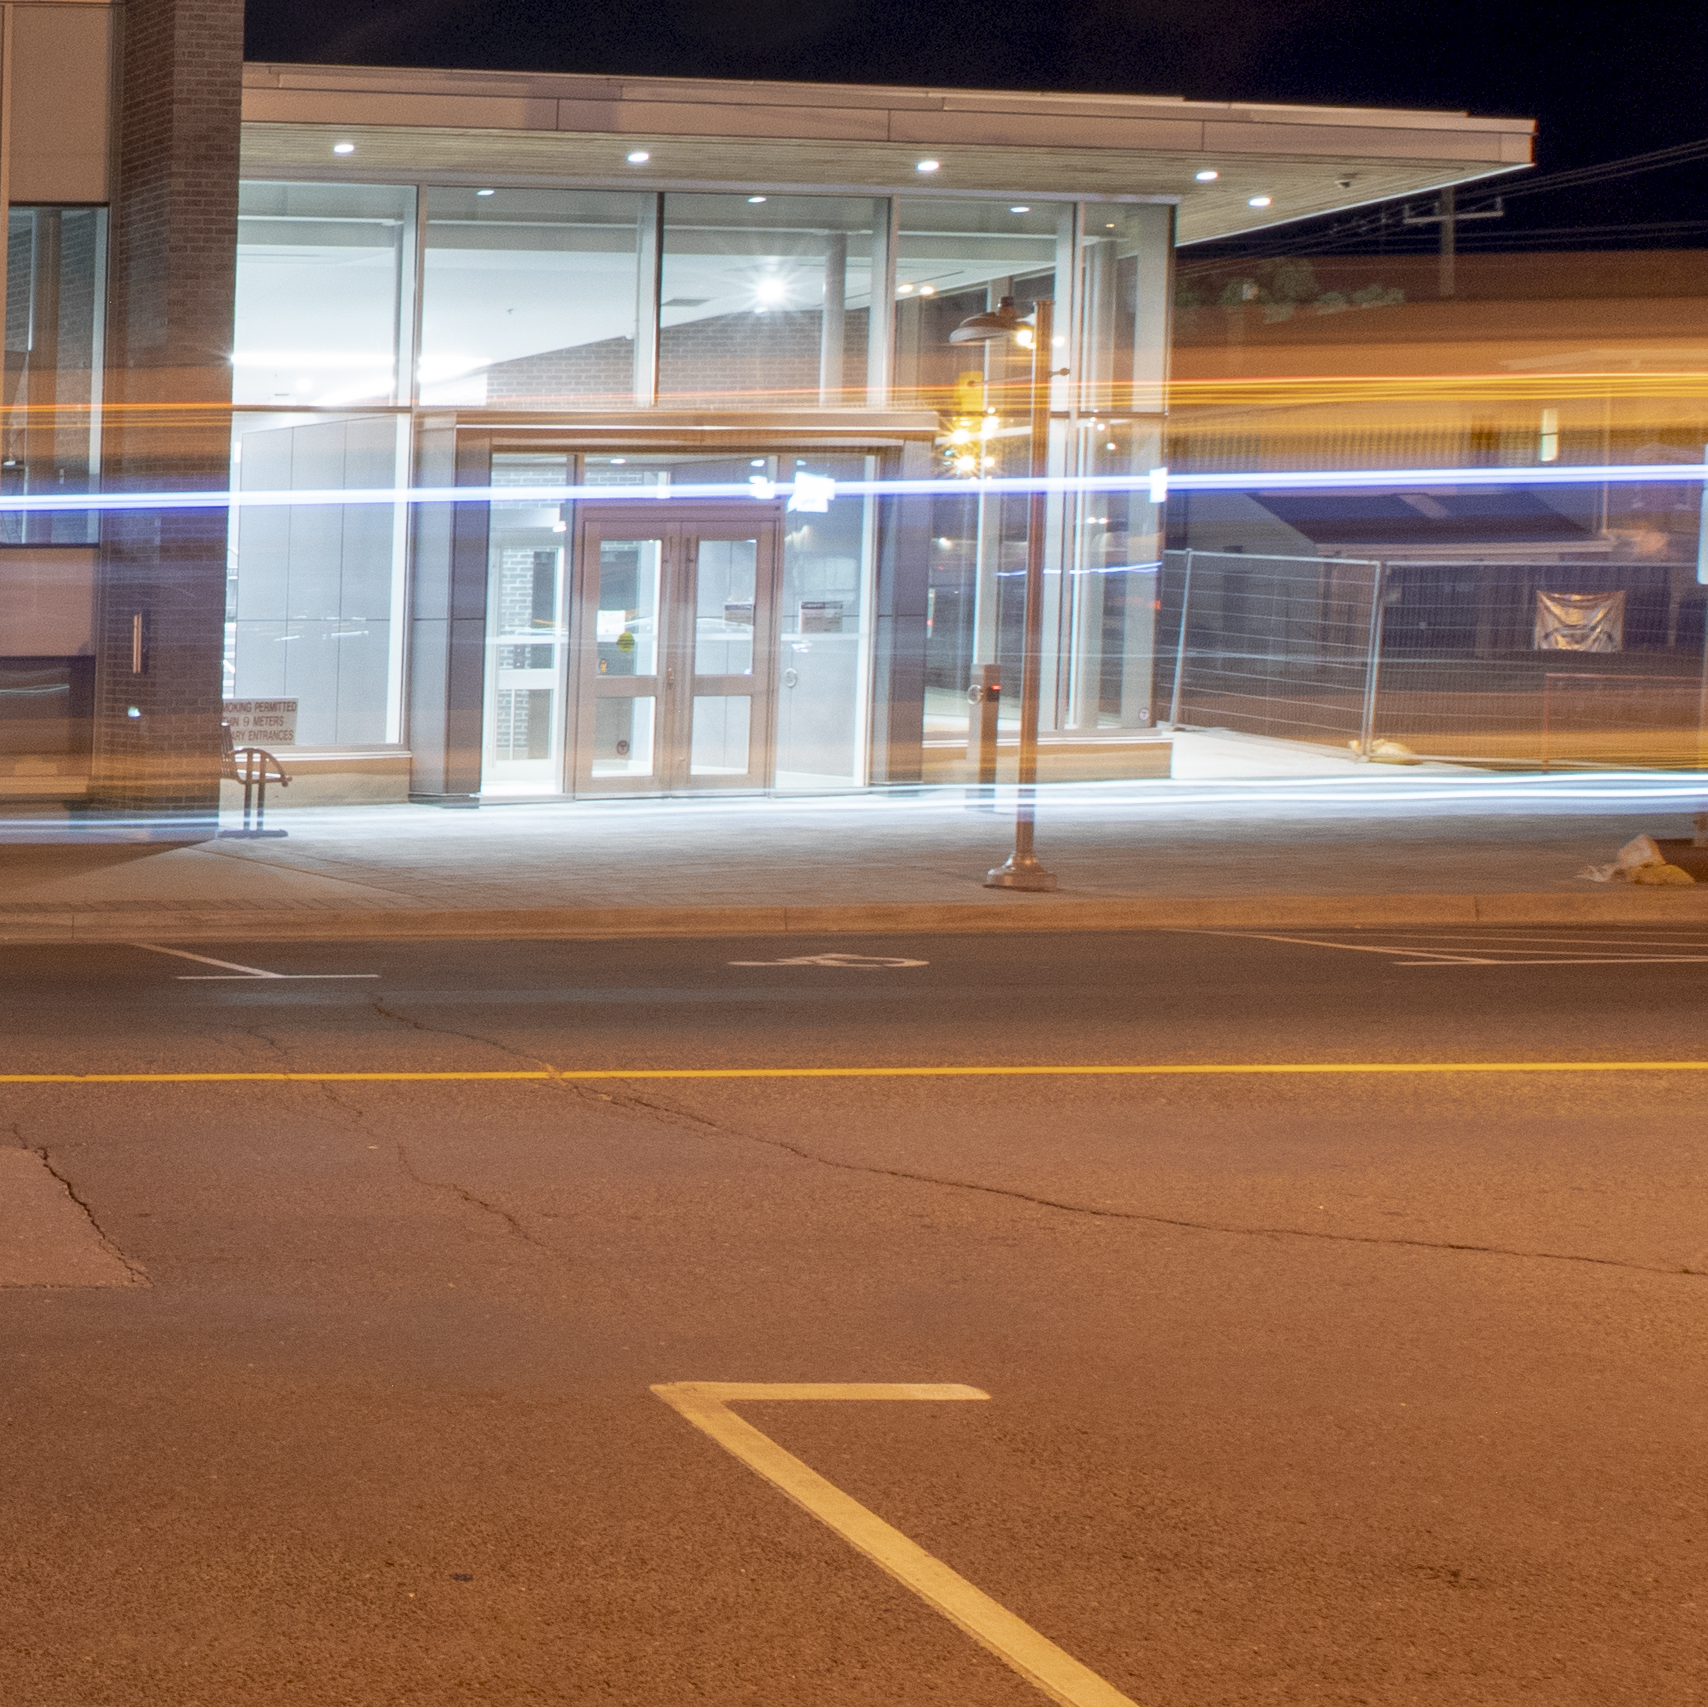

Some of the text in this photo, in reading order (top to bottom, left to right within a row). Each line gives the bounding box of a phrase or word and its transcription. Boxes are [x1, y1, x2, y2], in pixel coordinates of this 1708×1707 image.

[254, 701, 298, 713] PERMITTED
[243, 716, 250, 727] 9
[253, 715, 285, 727] METERS
[248, 730, 294, 742] ENTRANCES
